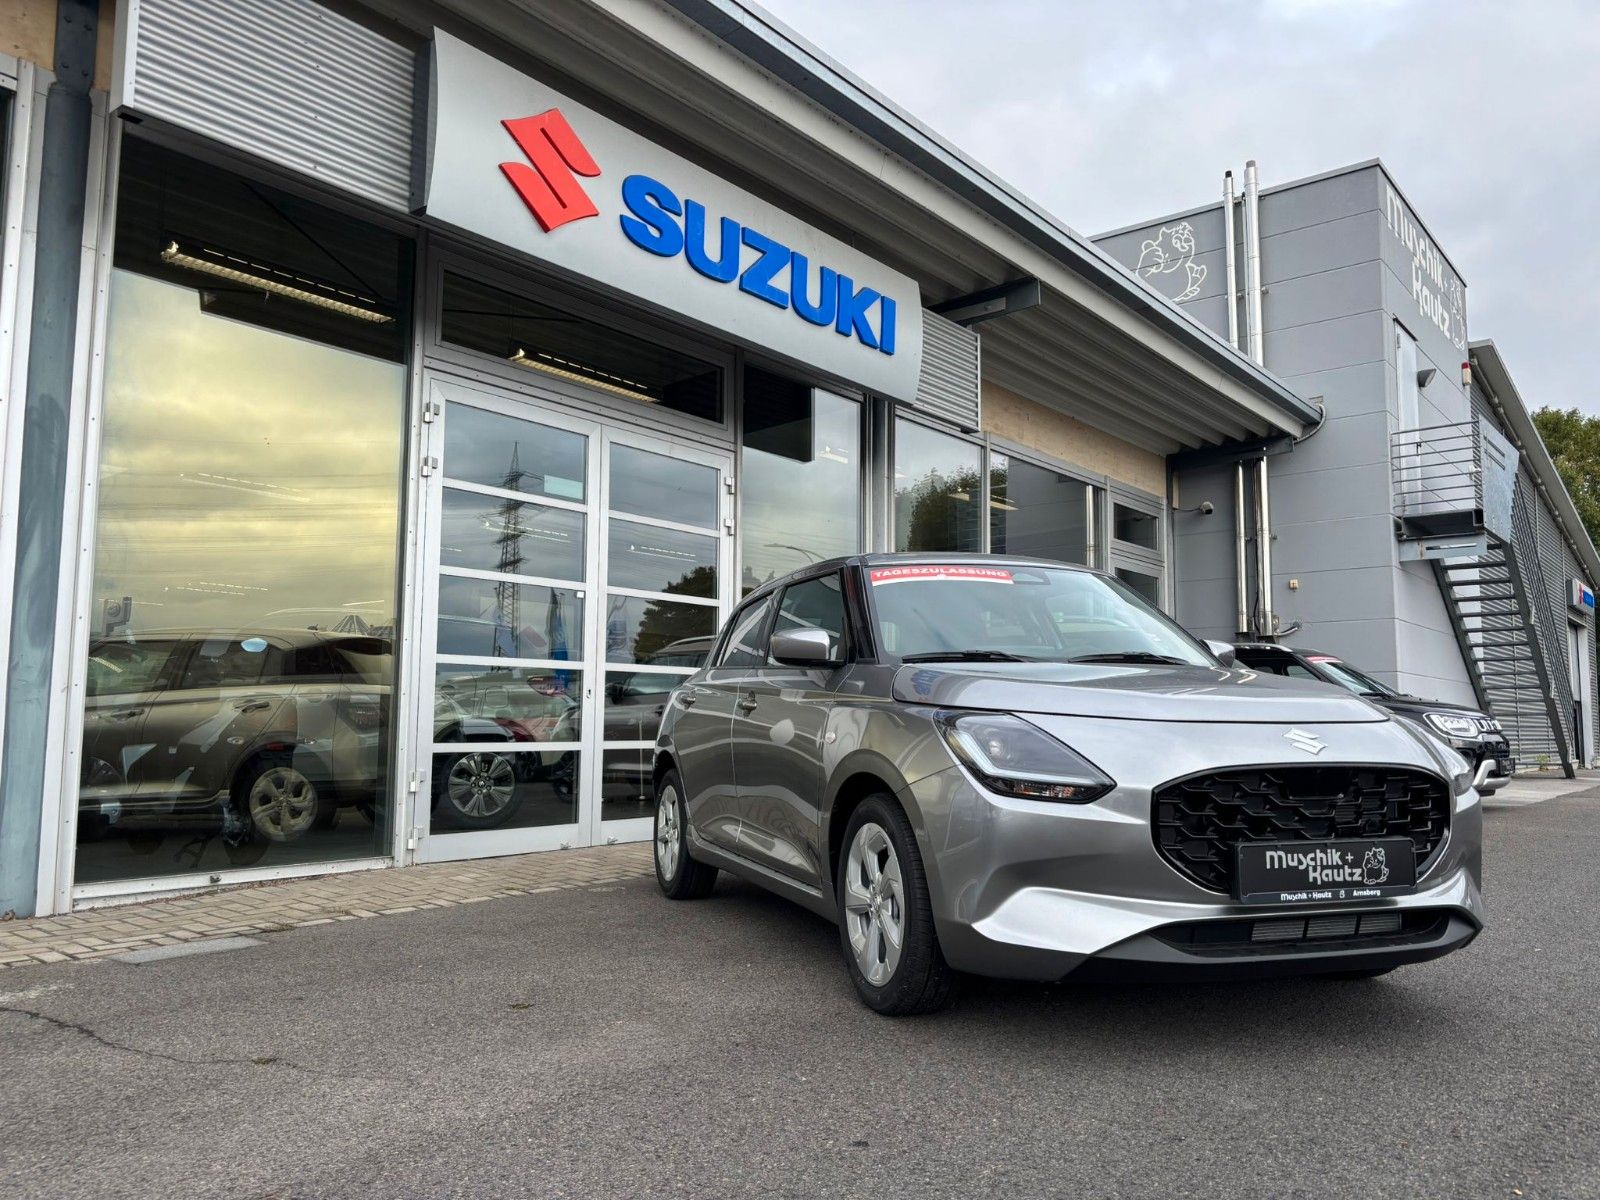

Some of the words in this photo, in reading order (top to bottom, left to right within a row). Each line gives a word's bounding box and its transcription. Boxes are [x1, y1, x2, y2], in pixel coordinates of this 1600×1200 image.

[620, 174, 896, 356] SUZUKI
[875, 567, 1008, 577] TAGESZULASSUNG
[1265, 849, 1343, 870] Muschik
[1352, 889, 1381, 897] Arnsberg
